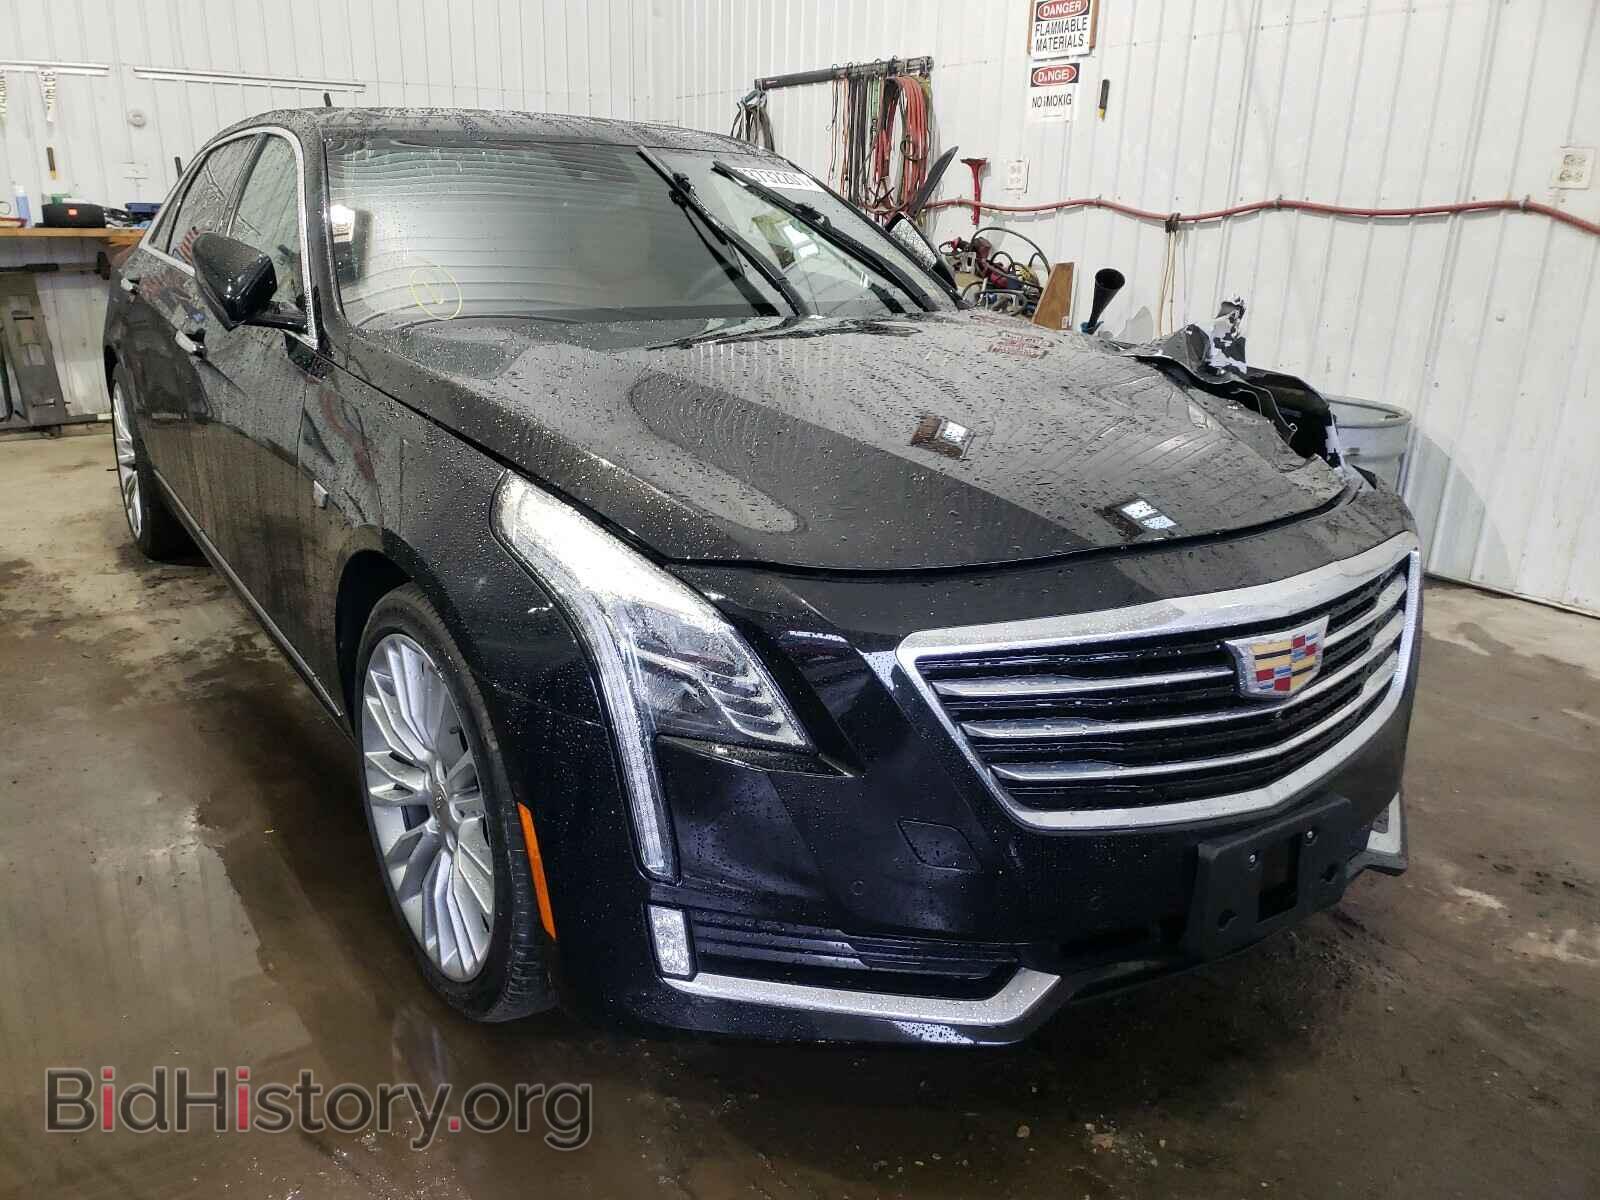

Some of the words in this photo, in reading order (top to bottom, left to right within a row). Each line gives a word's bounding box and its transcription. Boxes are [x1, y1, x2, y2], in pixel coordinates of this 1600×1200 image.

[1043, 1, 1082, 17] DANGER
[1035, 17, 1088, 37] FLAMMABLE
[1035, 33, 1084, 52] MATERIALS
[1032, 95, 1042, 108] NO
